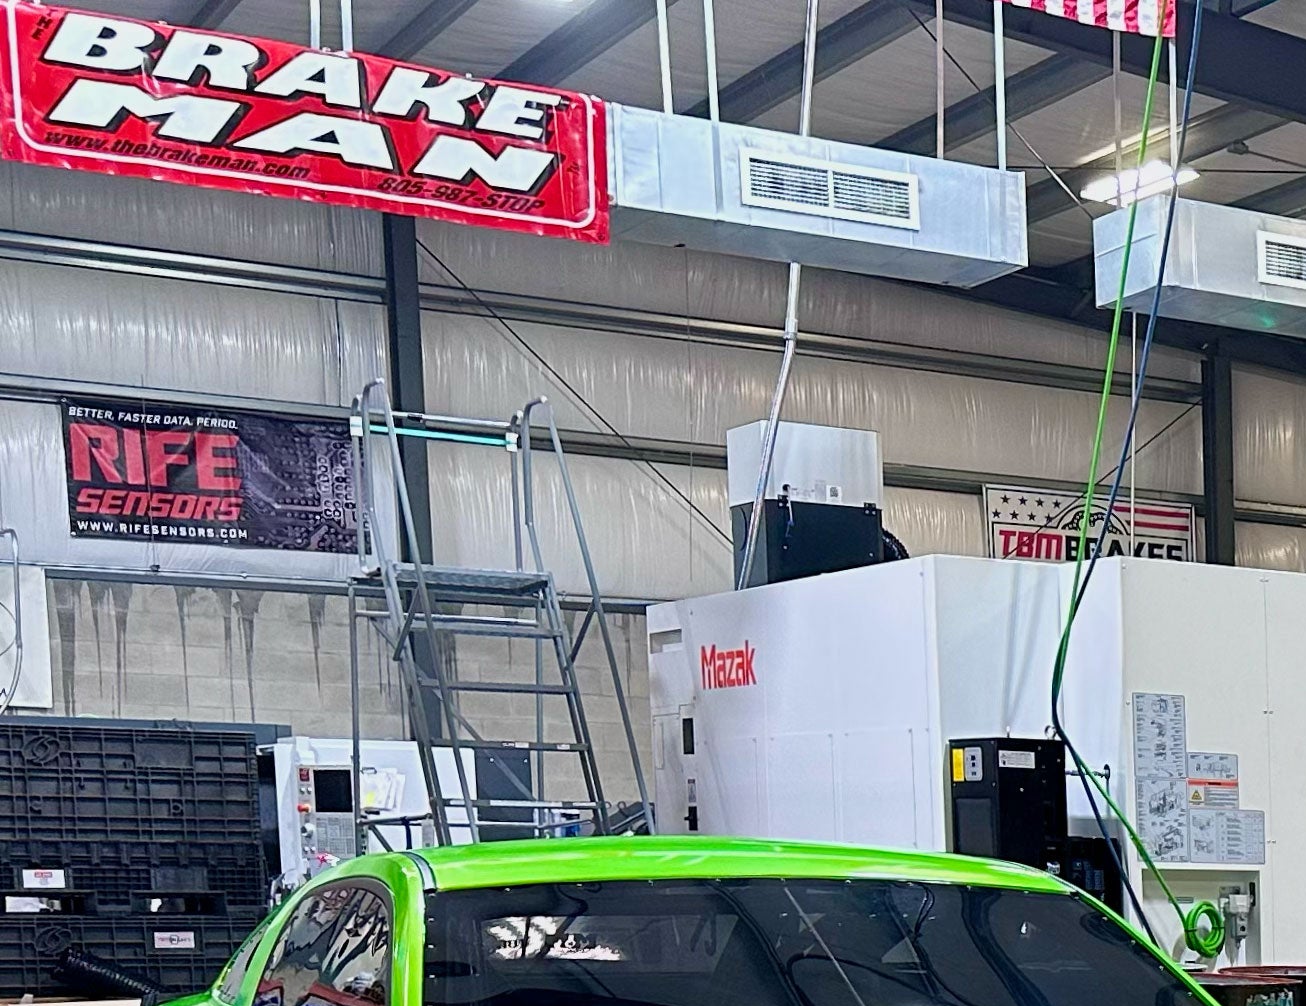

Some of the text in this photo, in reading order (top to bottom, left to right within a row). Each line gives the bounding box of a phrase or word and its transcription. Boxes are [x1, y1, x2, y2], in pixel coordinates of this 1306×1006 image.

[43, 12, 565, 140] BRAKE
[45, 131, 310, 179] www.thebrakeman.com
[48, 78, 560, 193] MAN
[377, 176, 545, 213] 805-987-STOP
[69, 406, 114, 420] BETTER,
[118, 412, 160, 425] FASTER
[197, 417, 239, 430] PERIOD.
[69, 423, 242, 491] RIFE
[76, 487, 243, 522] SENSORS
[77, 520, 248, 539] WWW.RIFESENSORS.COM
[701, 639, 757, 690] Mazak
